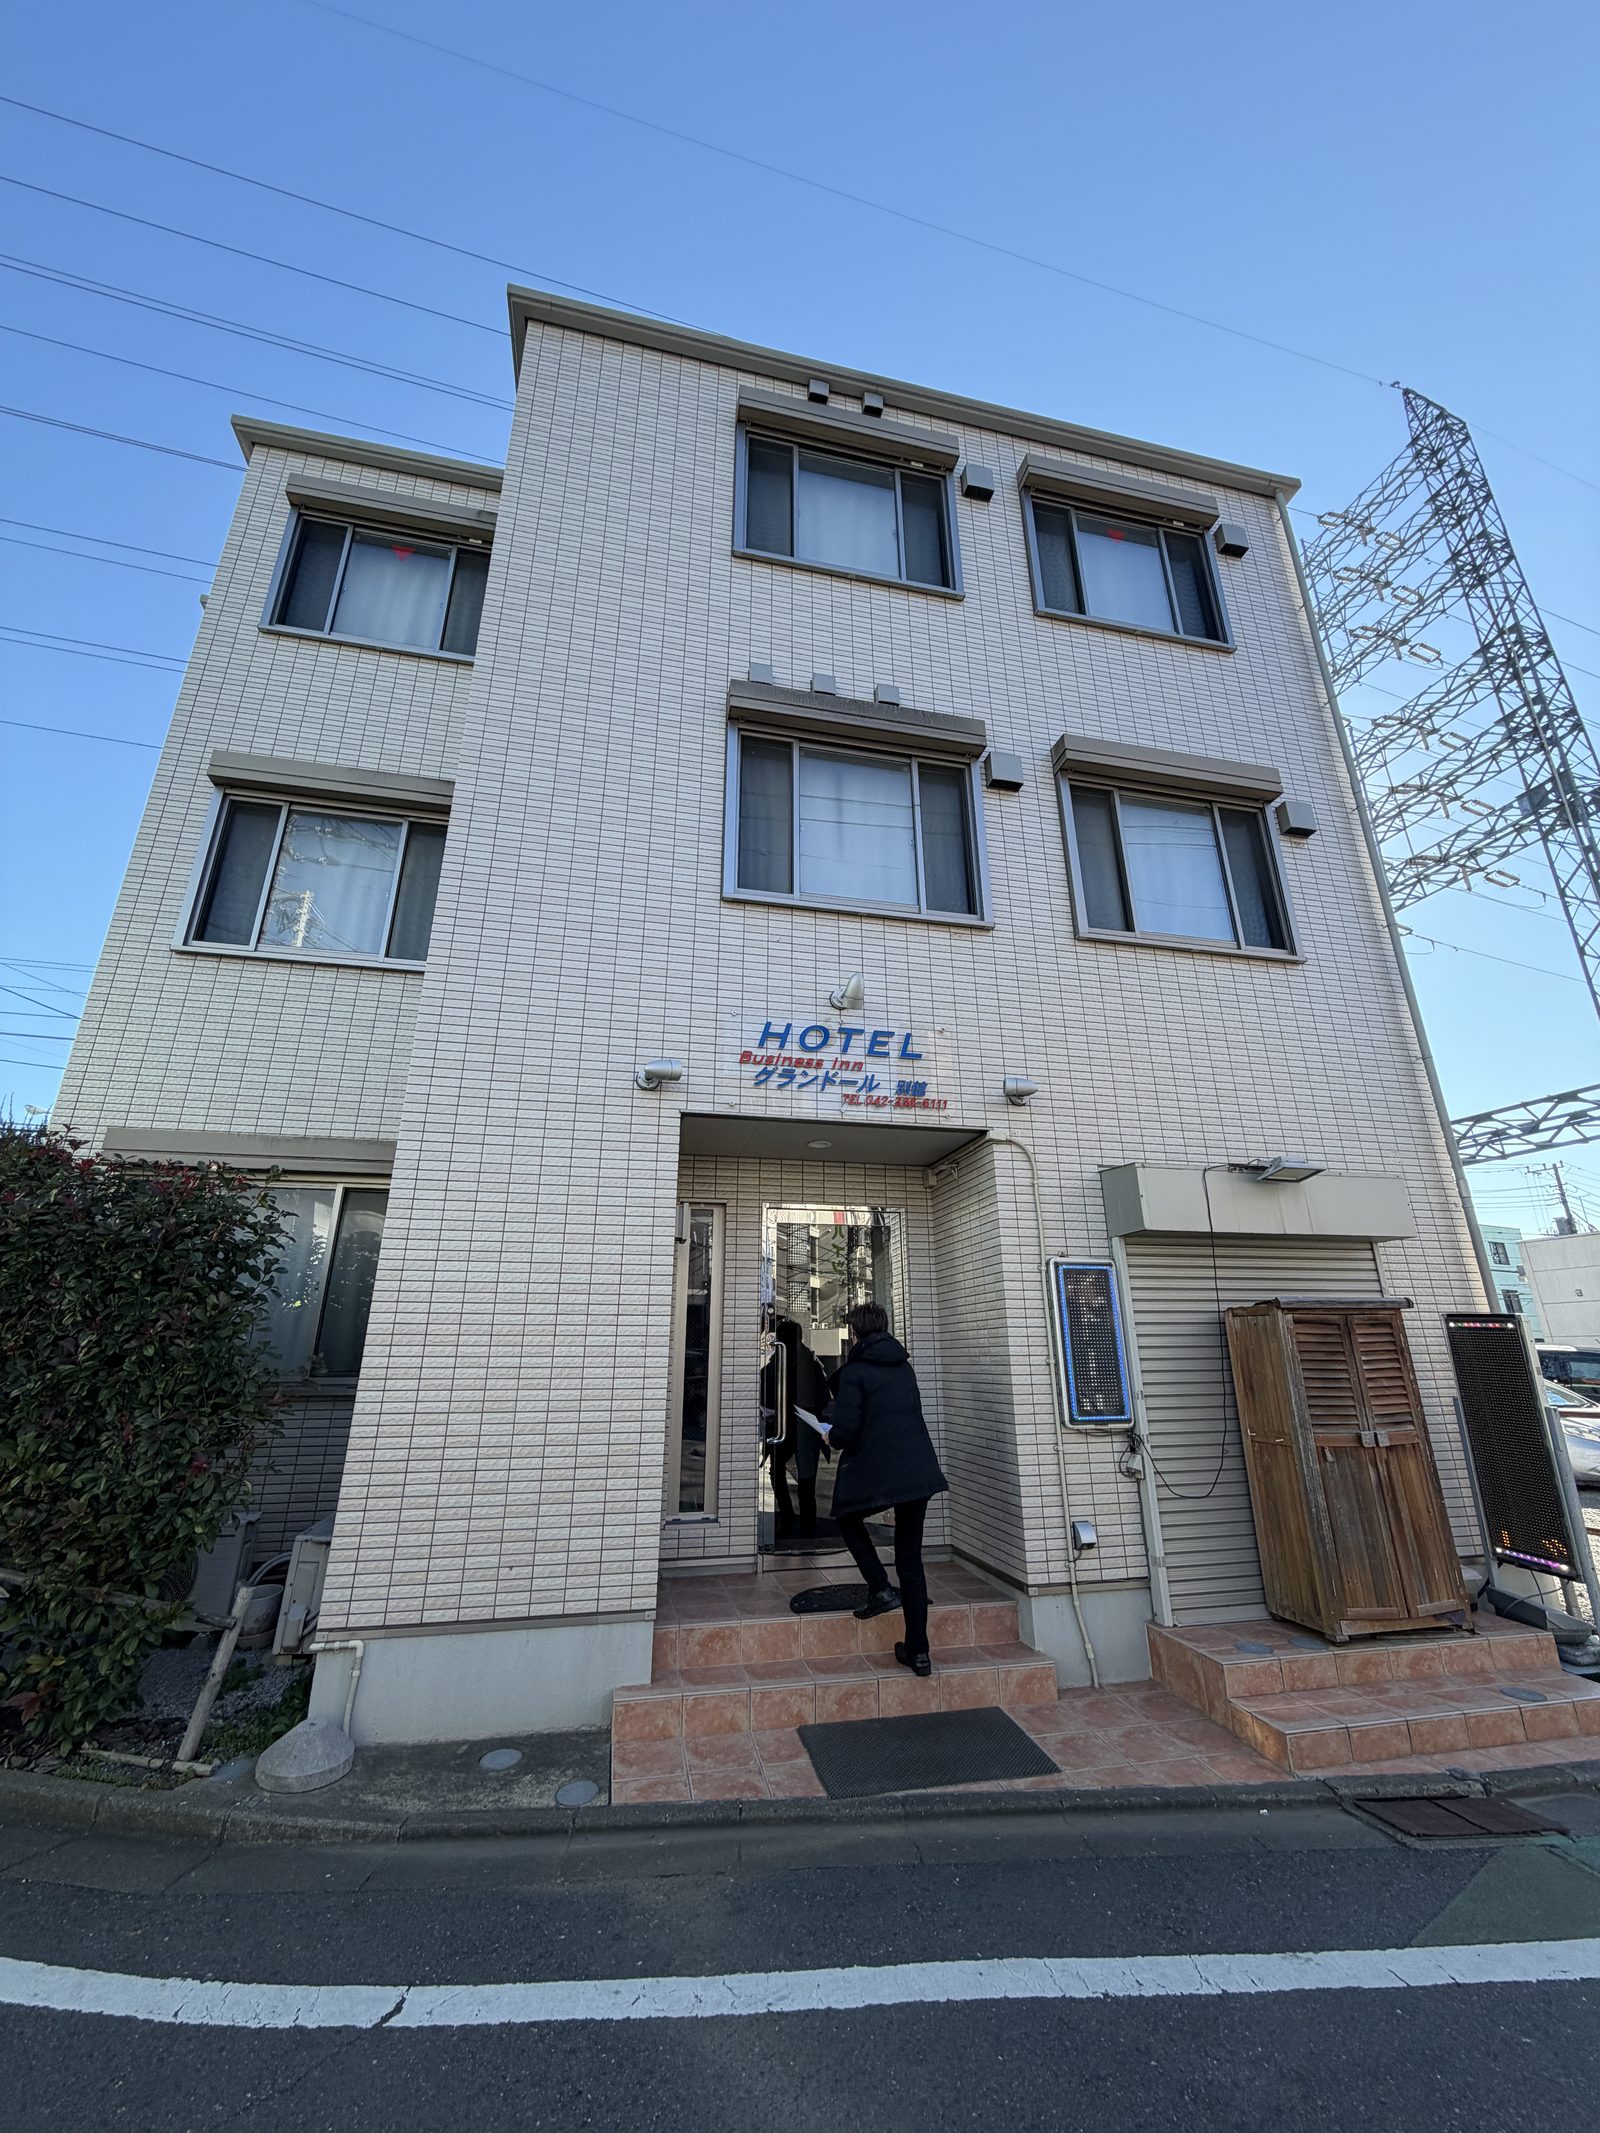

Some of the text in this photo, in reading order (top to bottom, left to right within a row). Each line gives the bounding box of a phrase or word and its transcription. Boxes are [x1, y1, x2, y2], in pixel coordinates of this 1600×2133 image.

[757, 1021, 923, 1059] HOTEL
[739, 1050, 824, 1069] Business
[754, 1066, 880, 1093] グランドール
[842, 1094, 862, 1106] TEL
